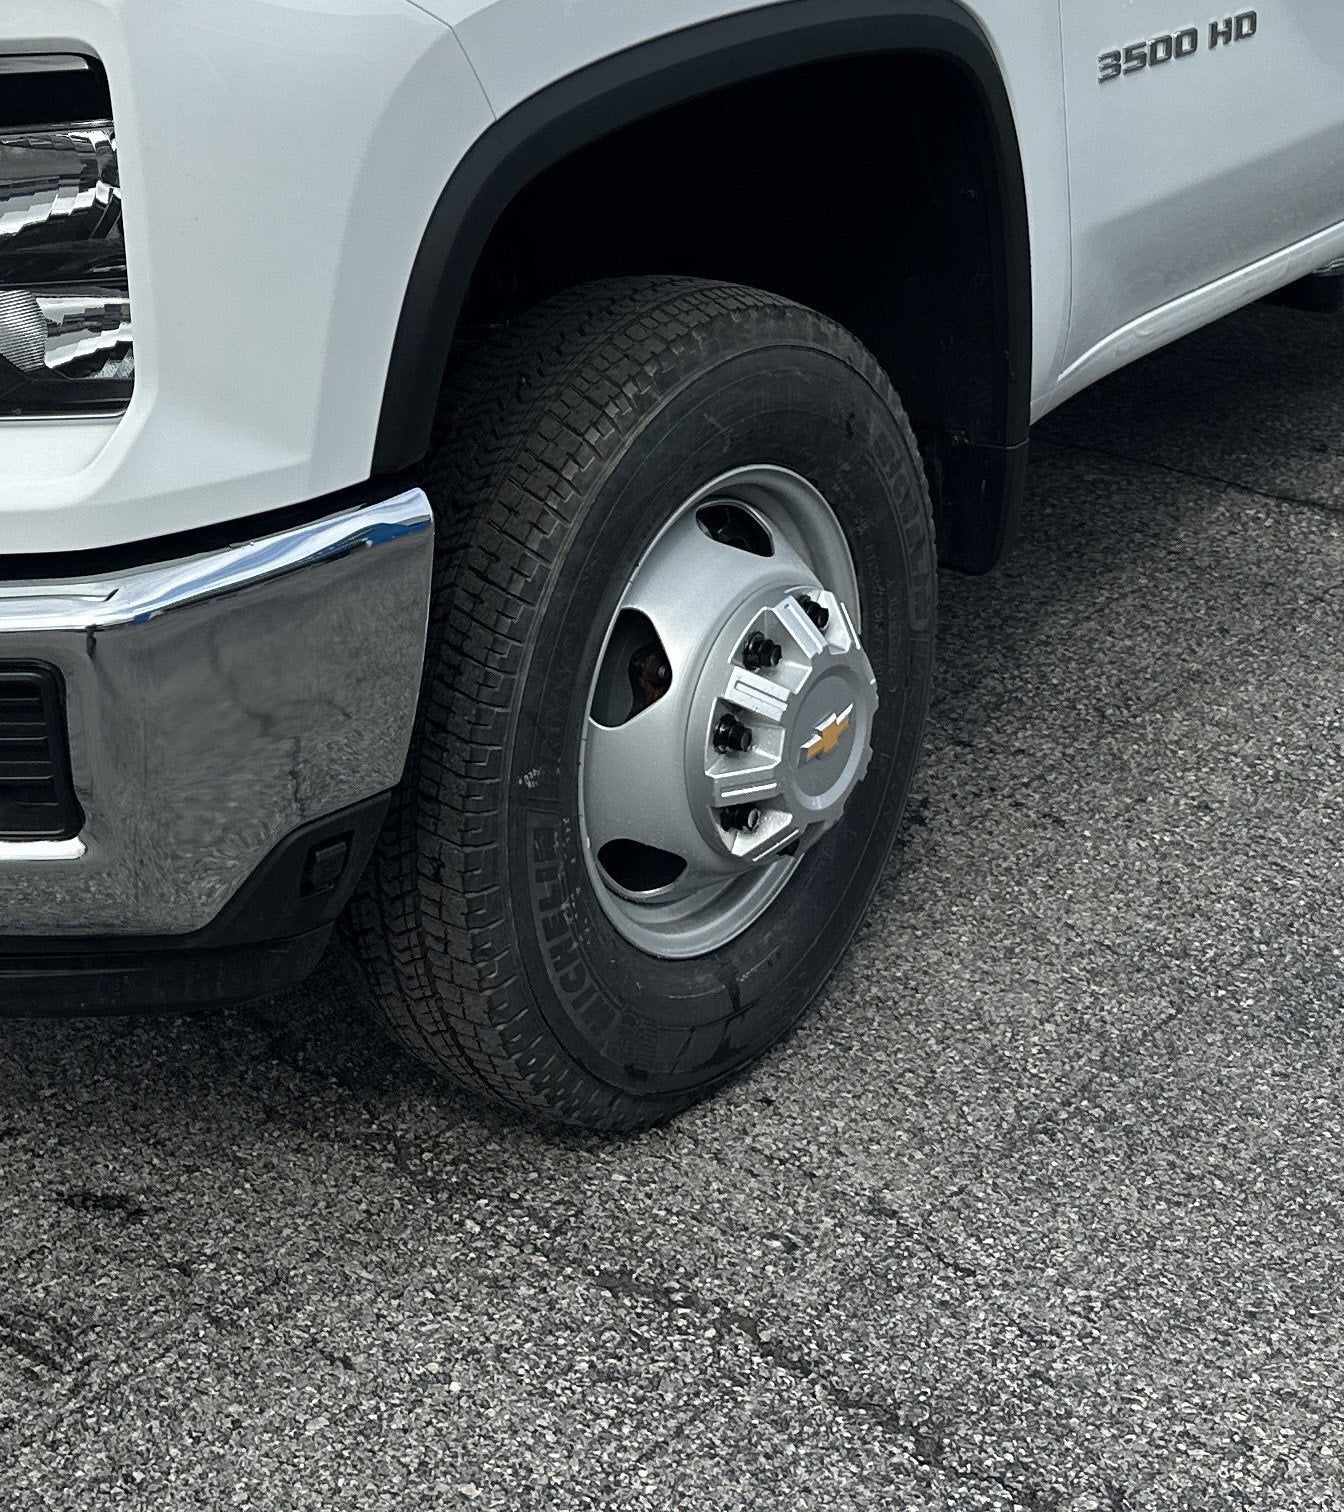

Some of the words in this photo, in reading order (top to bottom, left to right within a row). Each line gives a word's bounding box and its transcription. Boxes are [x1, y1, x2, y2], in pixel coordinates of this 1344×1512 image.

[1097, 27, 1199, 85] 3500
[1207, 9, 1258, 50] HD
[531, 825, 618, 1037] MICHELIN
